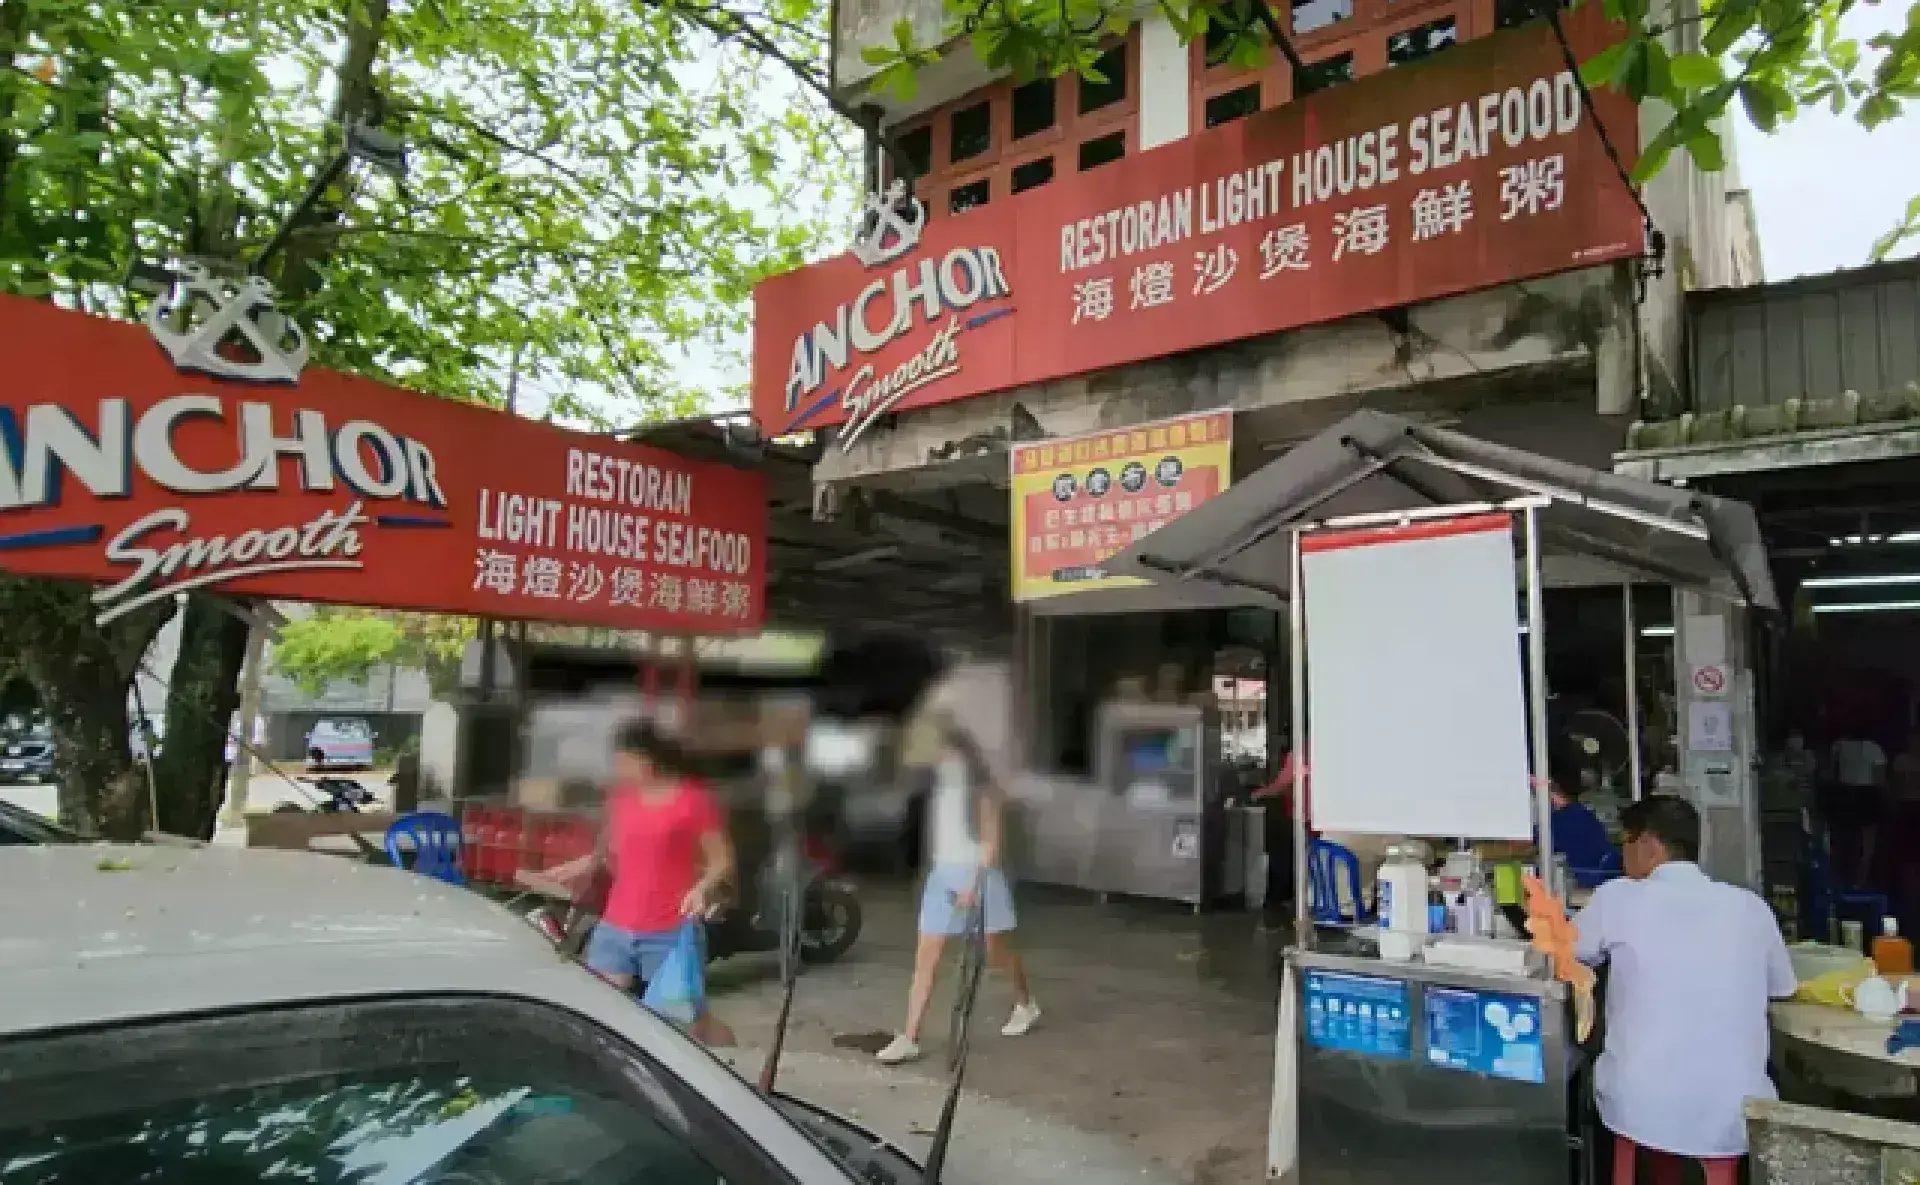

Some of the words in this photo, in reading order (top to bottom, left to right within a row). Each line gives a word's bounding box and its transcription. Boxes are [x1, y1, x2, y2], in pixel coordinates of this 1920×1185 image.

[1060, 185, 1192, 273] RESTORAN
[1200, 158, 1284, 235] LIGHT
[1292, 122, 1399, 208] HOUSE
[1409, 69, 1581, 174] SEAFOOD
[1071, 152, 1564, 325] 海燈沙煲海鮮粥
[785, 246, 1012, 412] ANCHOR
[837, 314, 963, 440] Smooth
[477, 488, 562, 547] LIGHT
[566, 503, 649, 562] HOUSE
[653, 521, 750, 575] SEAFOOD
[566, 447, 692, 516] RESTORAN
[90, 500, 369, 604] Smooth
[474, 548, 750, 618] 海燈沙煲海鮮粥
